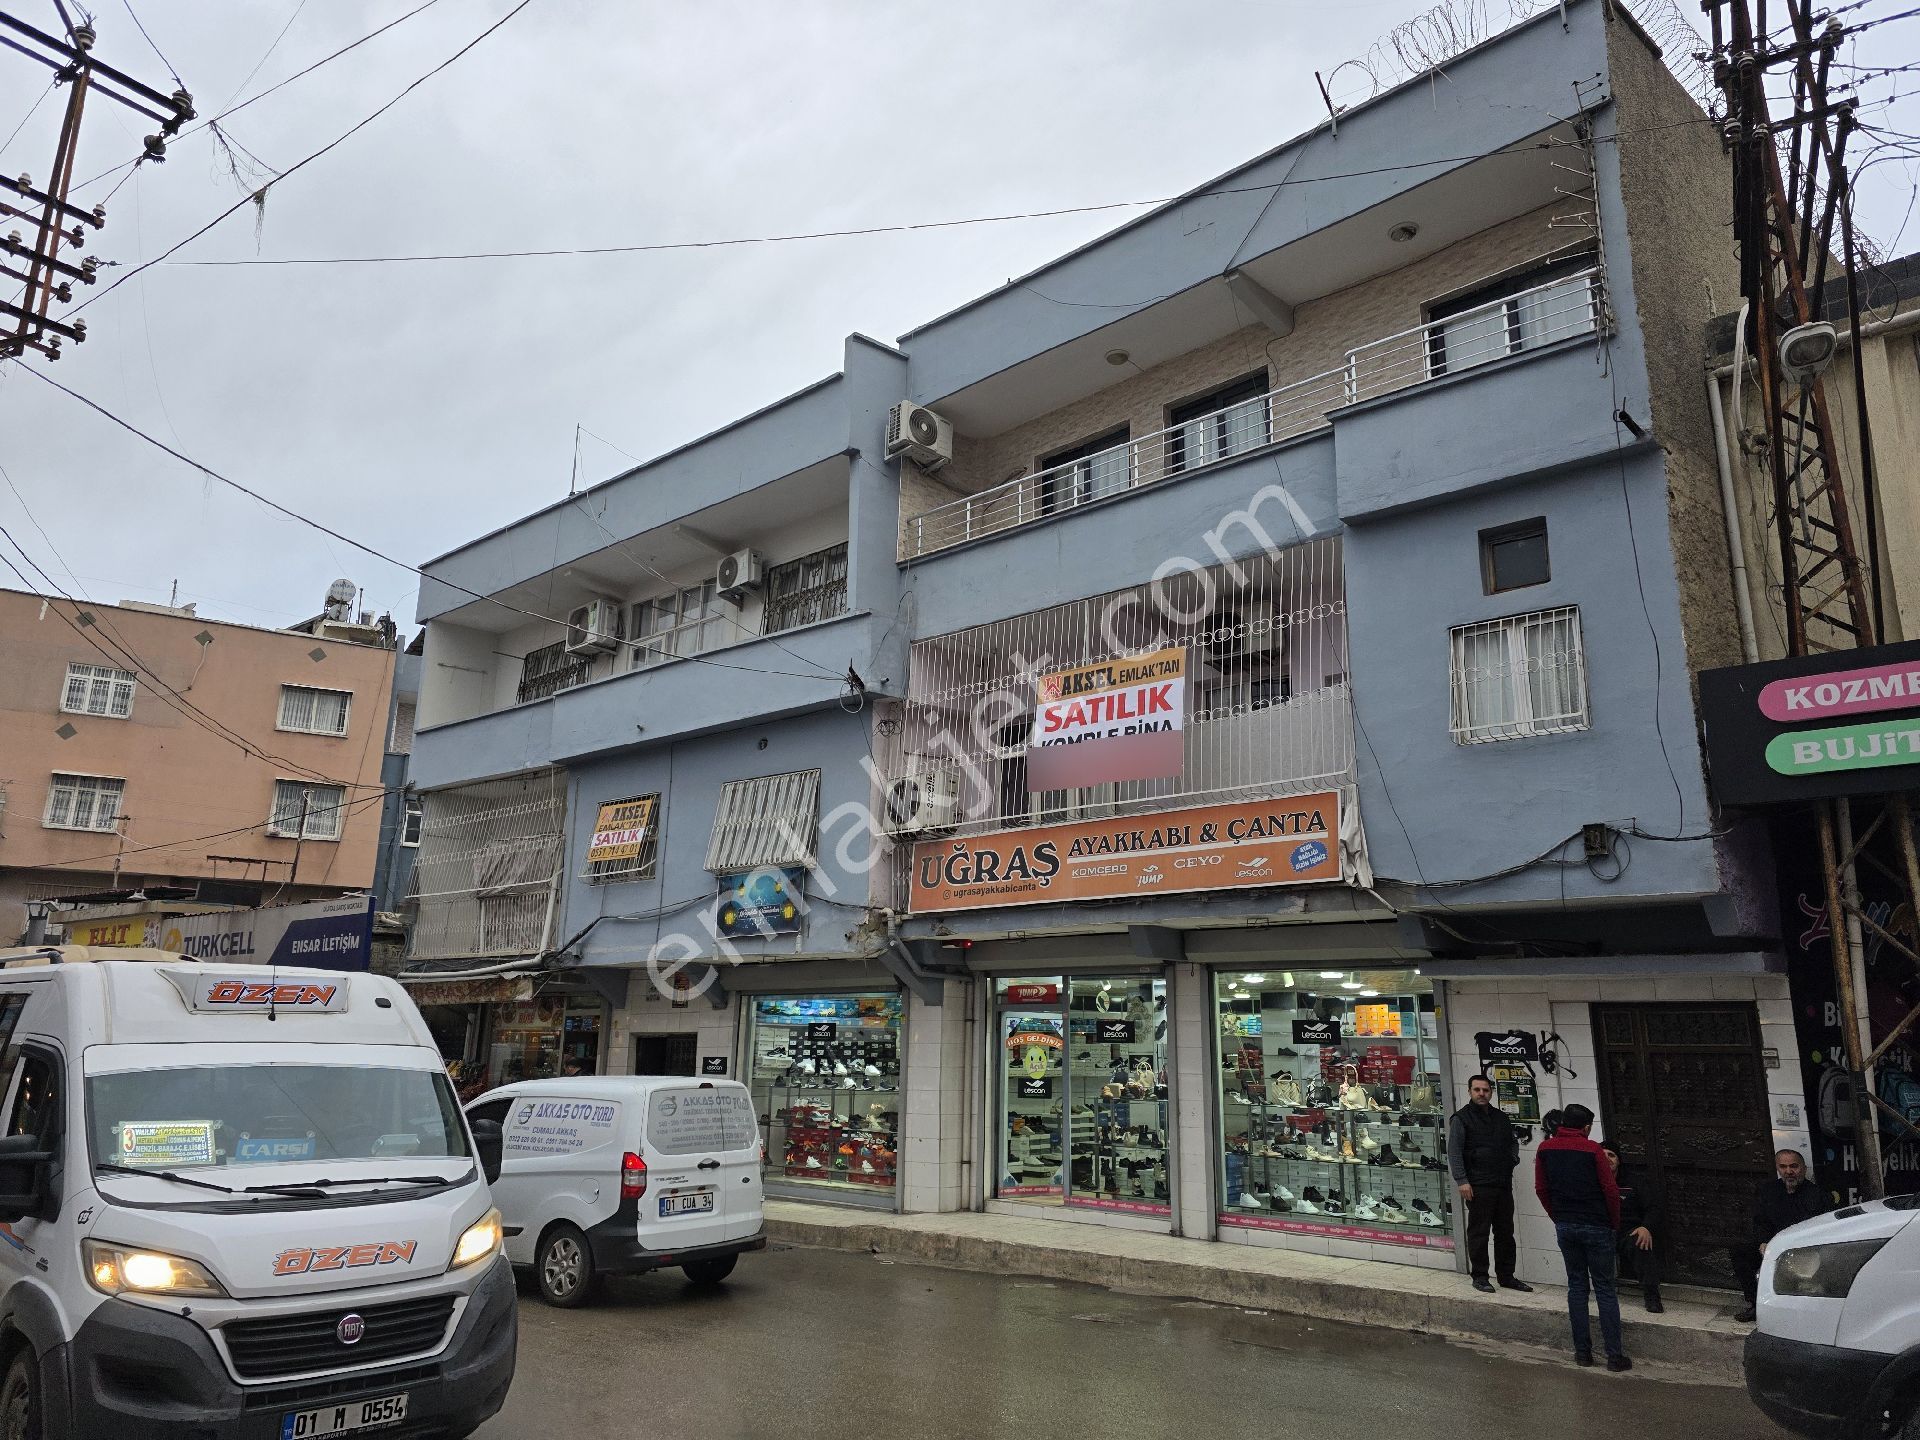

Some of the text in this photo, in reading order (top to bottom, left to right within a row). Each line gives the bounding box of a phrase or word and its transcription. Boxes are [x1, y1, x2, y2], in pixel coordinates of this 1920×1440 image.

[1062, 659, 1180, 695] AKSEL EMLAK'TAN
[1044, 684, 1173, 732] SATILIK
[594, 829, 640, 846] SATILIK
[1067, 810, 1328, 857] AYAKKABI & ÇANTA
[919, 841, 1061, 889] UĞRAŞ
[1071, 864, 1128, 876] KOMCERO
[1174, 855, 1222, 869] CEYO
[953, 883, 1036, 898] ugrasayakkabicanta
[1135, 873, 1164, 887] JUMP
[183, 931, 255, 958] TURKCELL
[291, 932, 360, 954] ENSAR İLETİŞİM
[207, 980, 337, 1007] ÖZEN
[571, 1104, 592, 1119] OTO
[592, 1106, 615, 1121] FORD
[124, 1129, 134, 1150] 3
[666, 1195, 711, 1211] 01 CUA 34
[272, 1240, 418, 1277] ÖZEN
[344, 1322, 361, 1337] FIAT
[295, 1412, 318, 1437] 01
[333, 1407, 346, 1429] M
[361, 1398, 404, 1424] 0554
